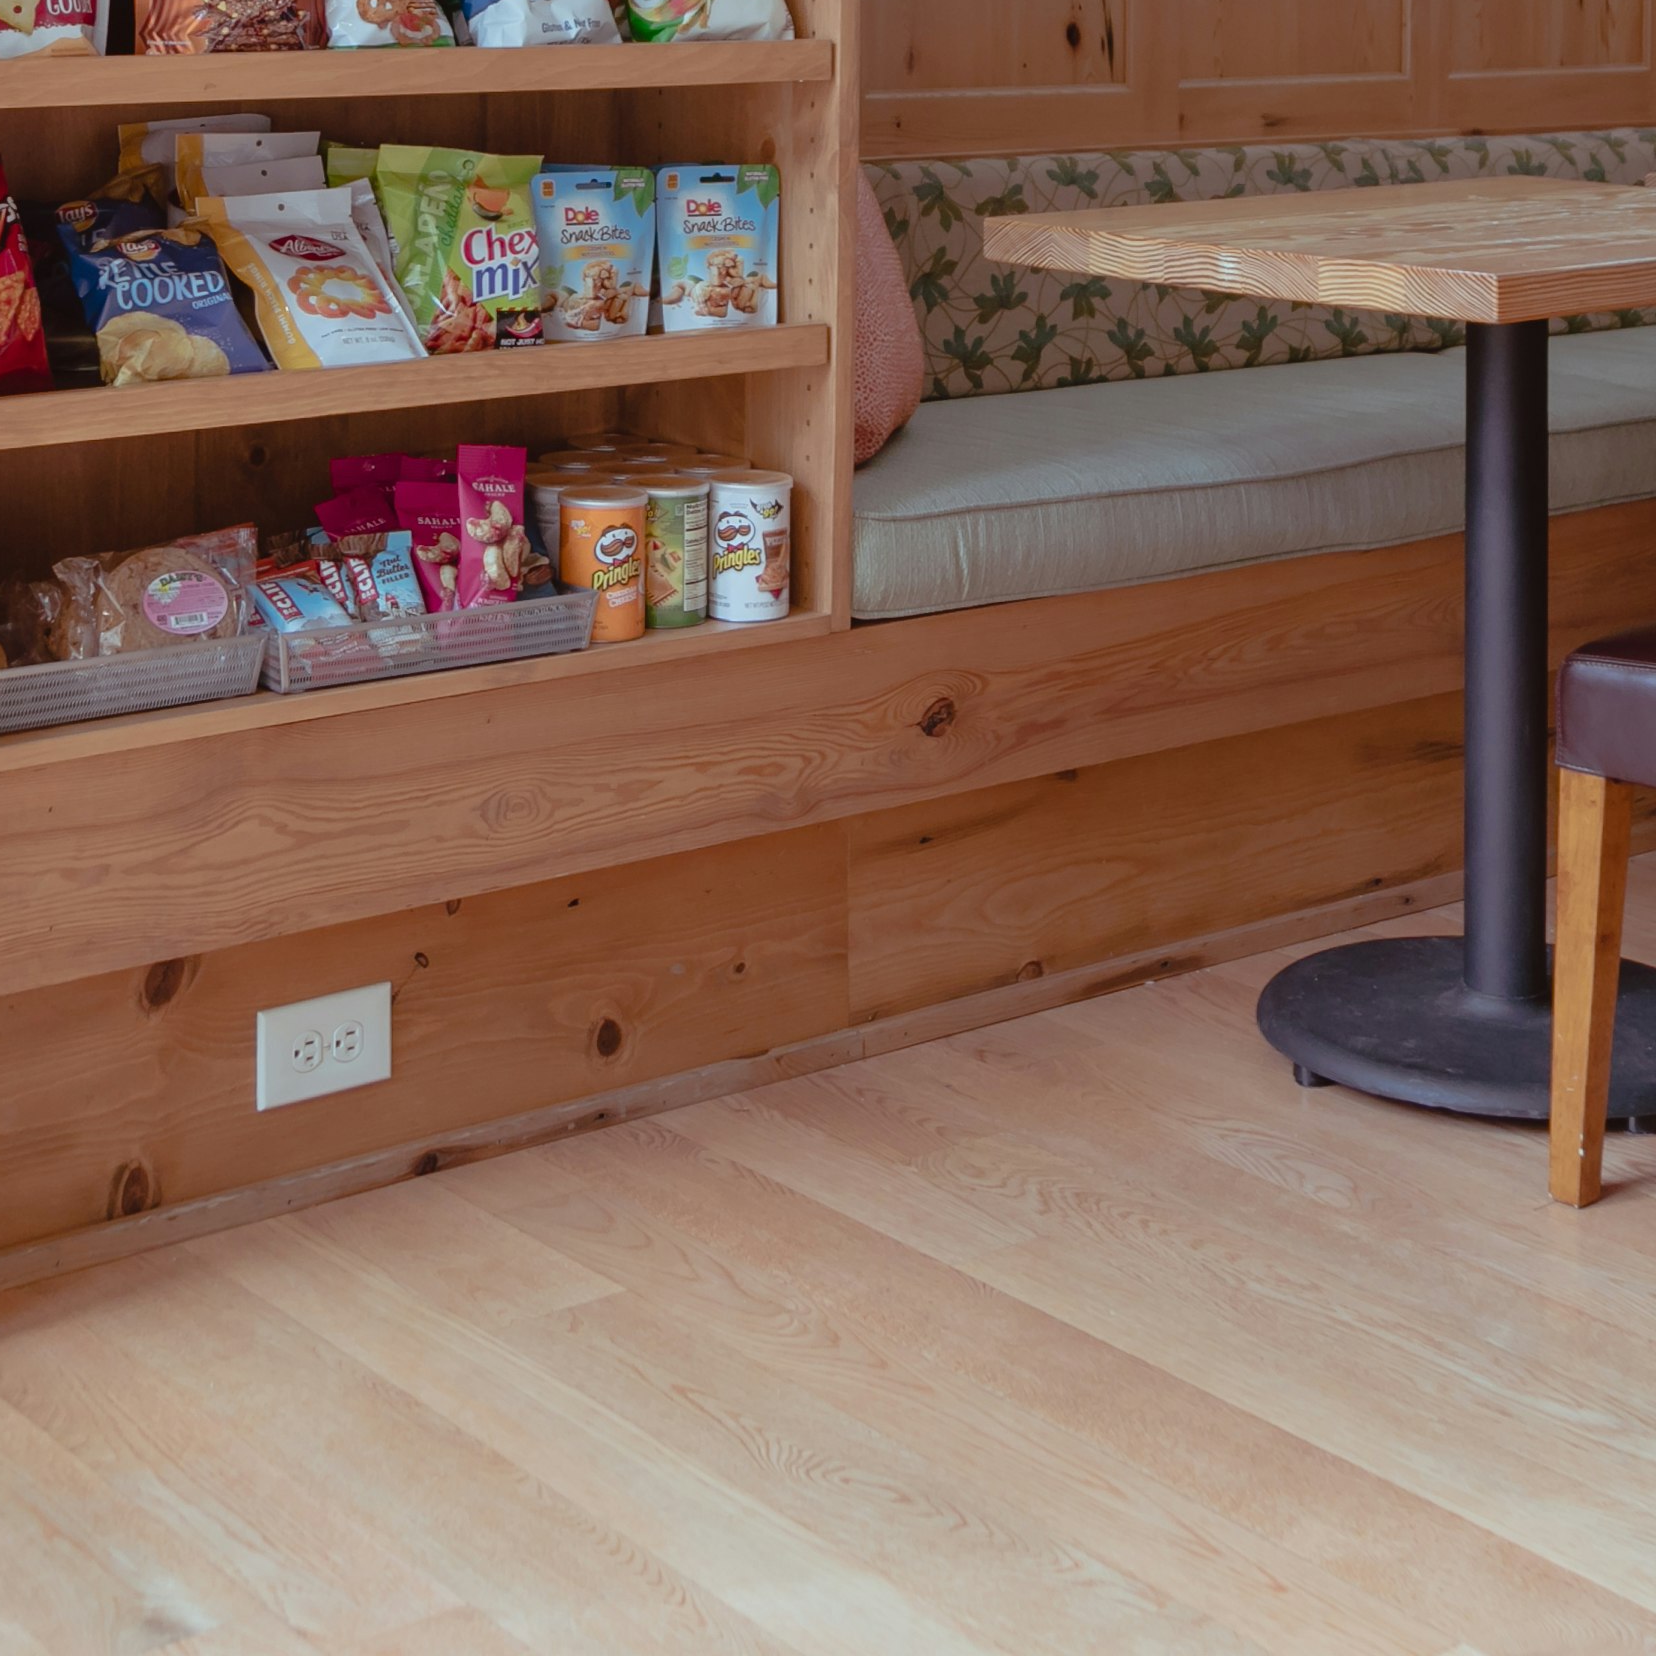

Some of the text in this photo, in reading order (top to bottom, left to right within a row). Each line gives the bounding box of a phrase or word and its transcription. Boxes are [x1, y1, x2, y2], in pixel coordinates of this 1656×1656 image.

[564, 206, 600, 224] Dole
[686, 198, 722, 216] Dole
[560, 224, 631, 244] Snack Bites
[683, 216, 756, 234] Snack Bites
[463, 224, 538, 266] Chex
[476, 256, 539, 299] mix
[115, 270, 224, 310] COOKED
[472, 482, 516, 493] SAHALE
[378, 554, 402, 567] Nut
[712, 547, 761, 579] Pringles
[376, 564, 410, 579] Butter
[382, 573, 410, 585] FILLED
[592, 557, 641, 591] Pringles
